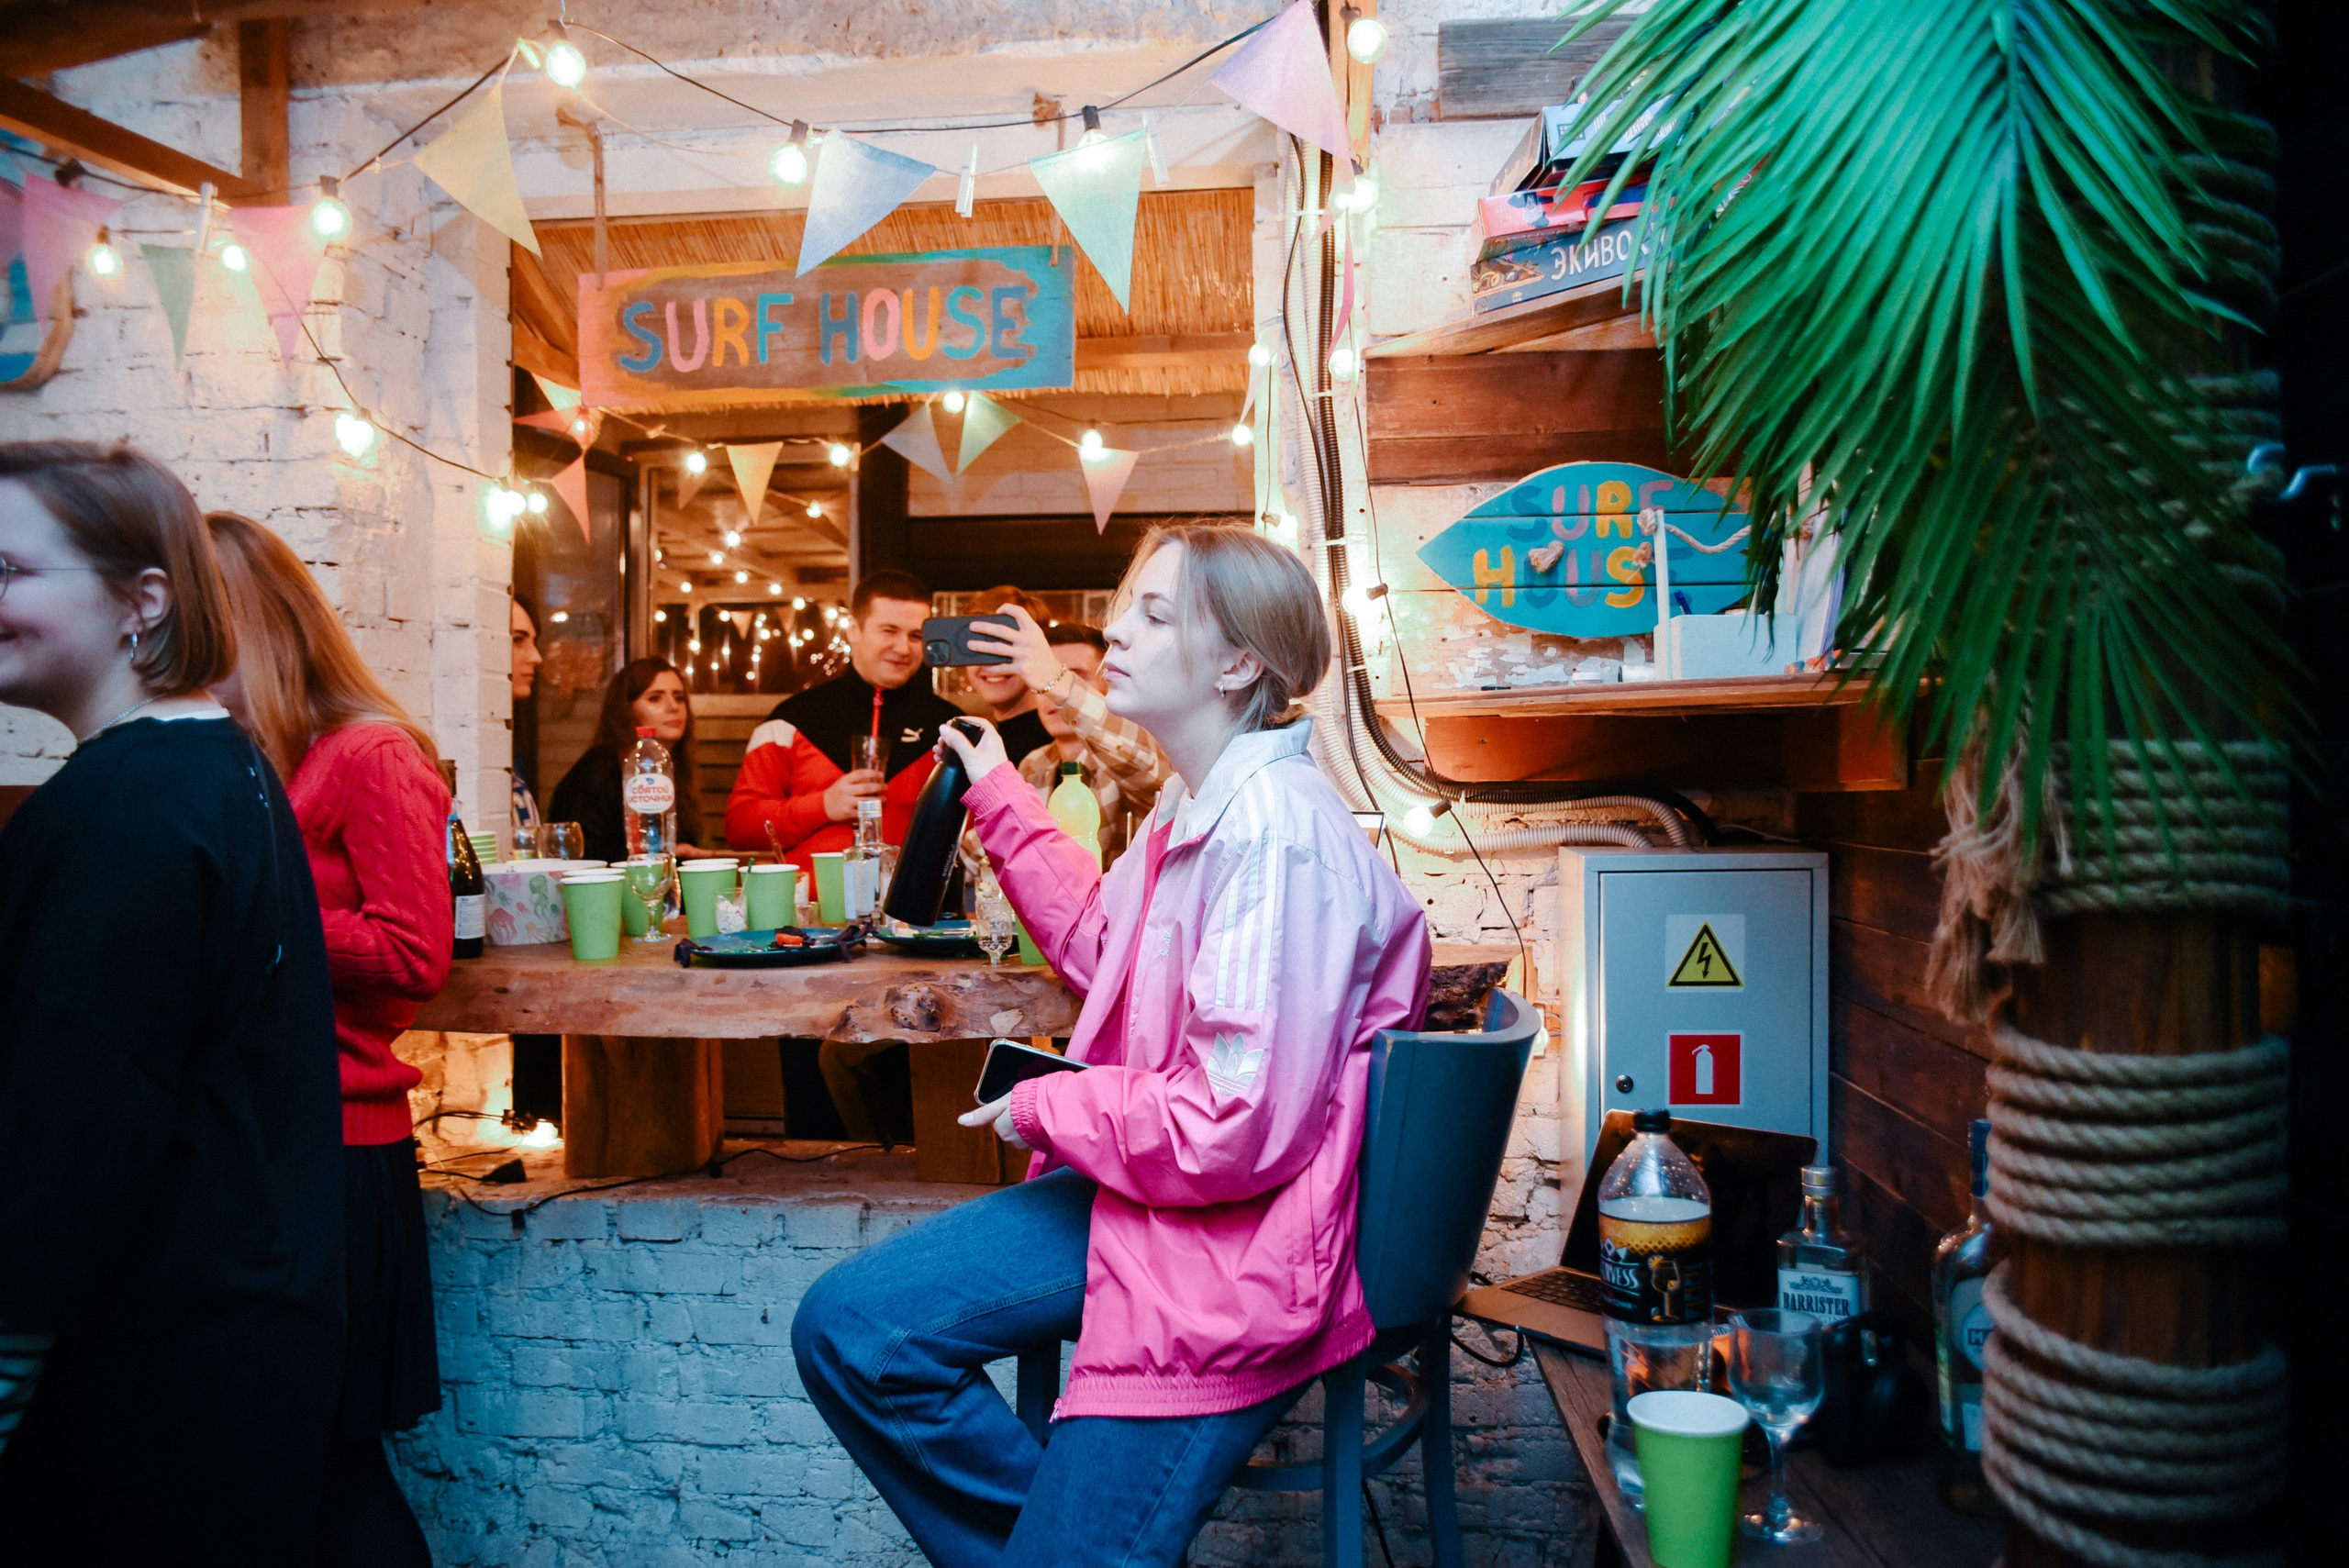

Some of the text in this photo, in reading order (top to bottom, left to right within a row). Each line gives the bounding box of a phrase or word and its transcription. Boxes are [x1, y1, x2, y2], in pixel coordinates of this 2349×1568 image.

[1551, 224, 1665, 281] ЭКИВО
[619, 284, 1030, 373] SURF HOUSE
[1507, 479, 1674, 541] SURF
[1783, 1292, 1851, 1317] BARRISTER
